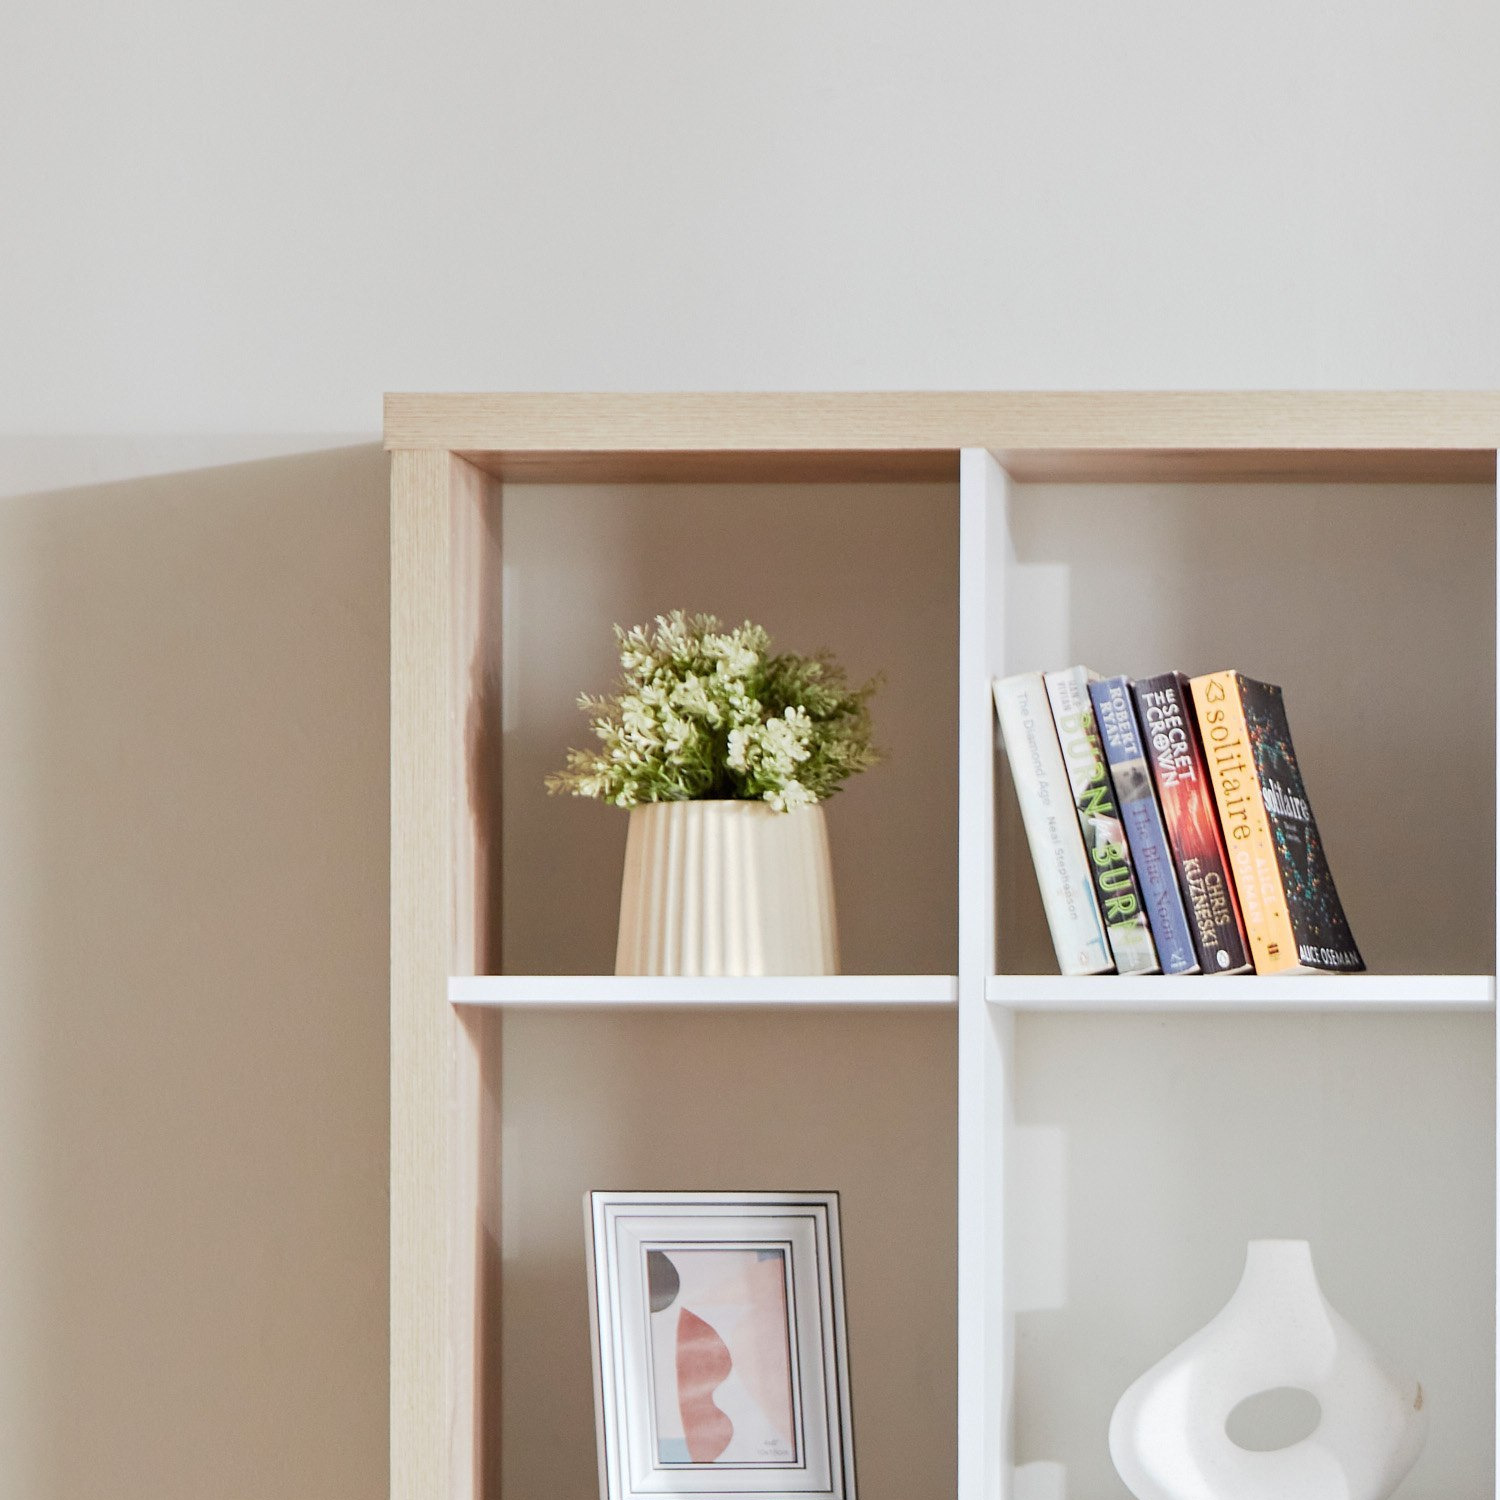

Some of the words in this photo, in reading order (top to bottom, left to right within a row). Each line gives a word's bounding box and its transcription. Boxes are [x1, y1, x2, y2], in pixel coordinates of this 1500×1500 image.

[1099, 700, 1121, 747] RYAN
[1109, 686, 1136, 755] ROBERT
[1141, 687, 1176, 710] THE
[1058, 709, 1116, 817] BURN
[1144, 705, 1179, 788] CROWN
[1161, 703, 1196, 784] SECRET
[1206, 707, 1252, 842] solitaire
[1262, 778, 1309, 821] solitaire
[1132, 804, 1152, 839] The
[1143, 844, 1163, 885] Blue
[1154, 889, 1176, 941] Noon
[1183, 857, 1216, 948] KUZNESKI
[1204, 870, 1228, 926] CHRIS
[1299, 944, 1320, 965] ALICE
[1321, 947, 1359, 967] OSEMAN
